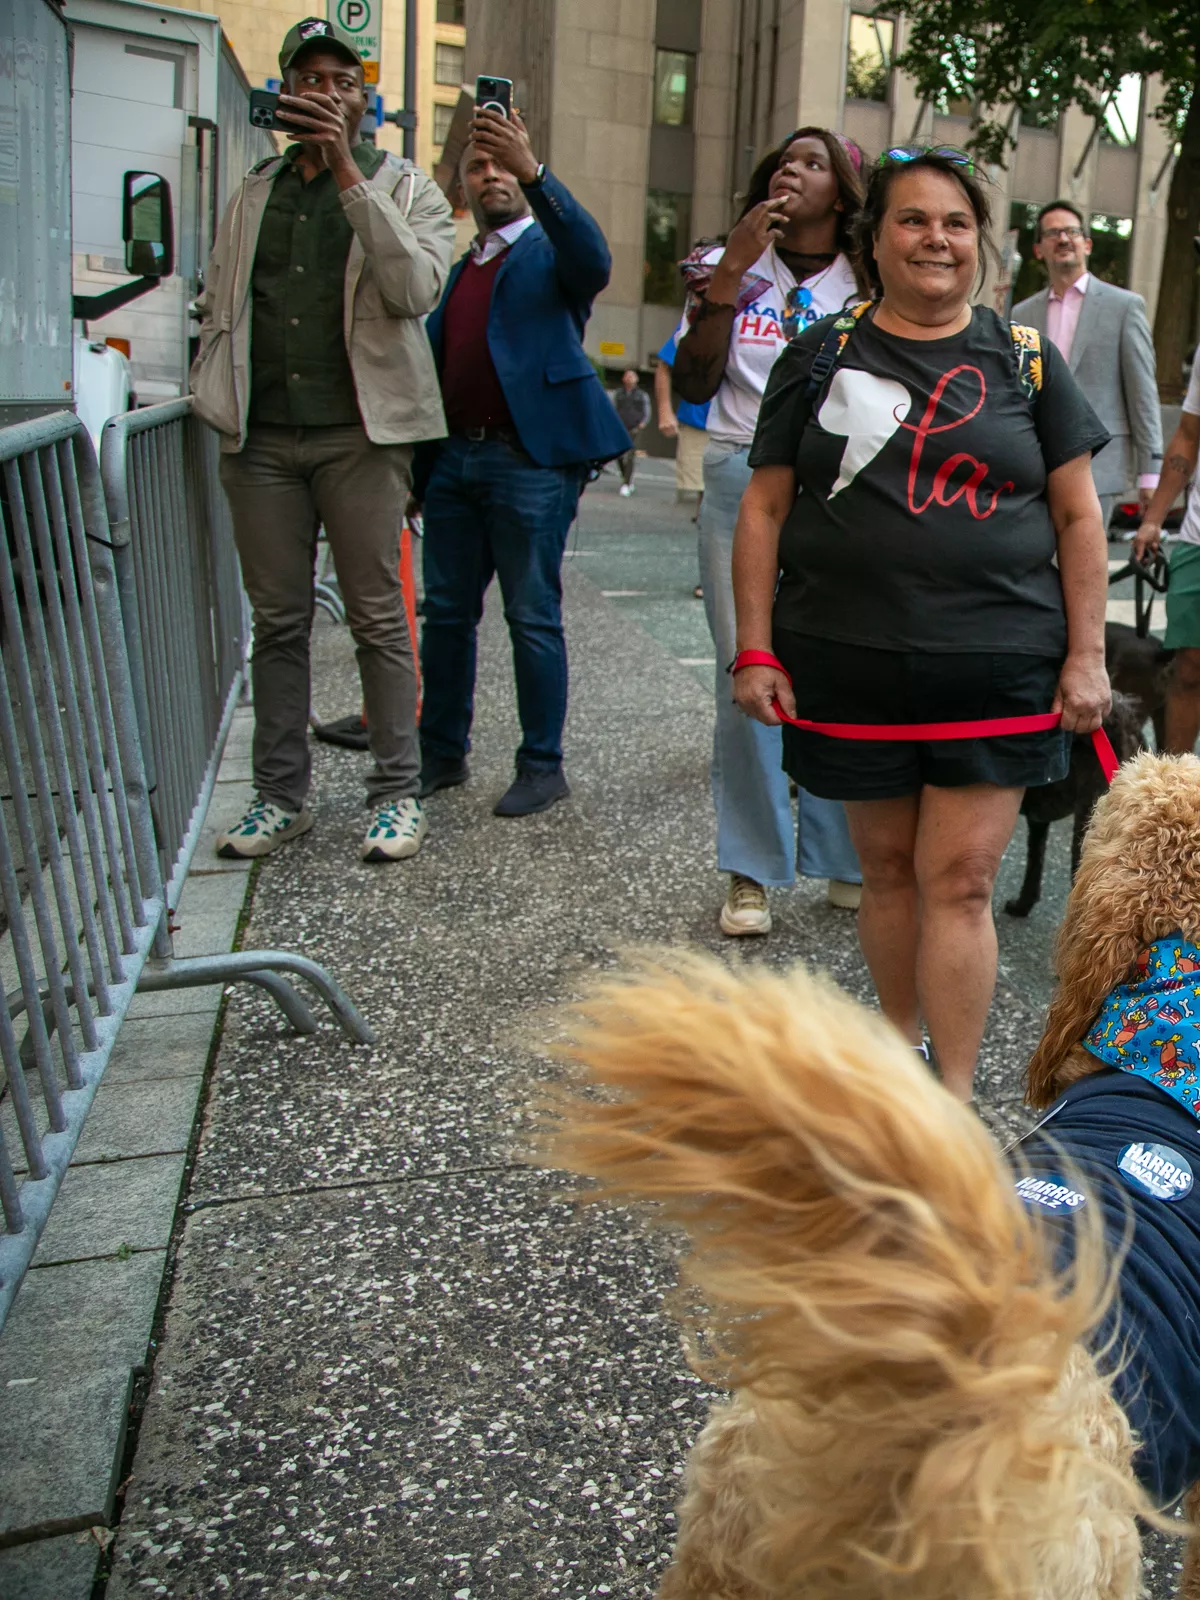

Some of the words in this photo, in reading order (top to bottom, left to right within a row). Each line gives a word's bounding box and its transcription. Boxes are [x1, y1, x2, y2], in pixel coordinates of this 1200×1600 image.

[347, 2, 363, 26] P
[352, 36, 377, 48] RKING
[1124, 1143, 1192, 1190] HARRIS
[1129, 1162, 1174, 1193] WALZ
[1014, 1176, 1086, 1207] HARRIS
[1016, 1189, 1060, 1209] WALZ
